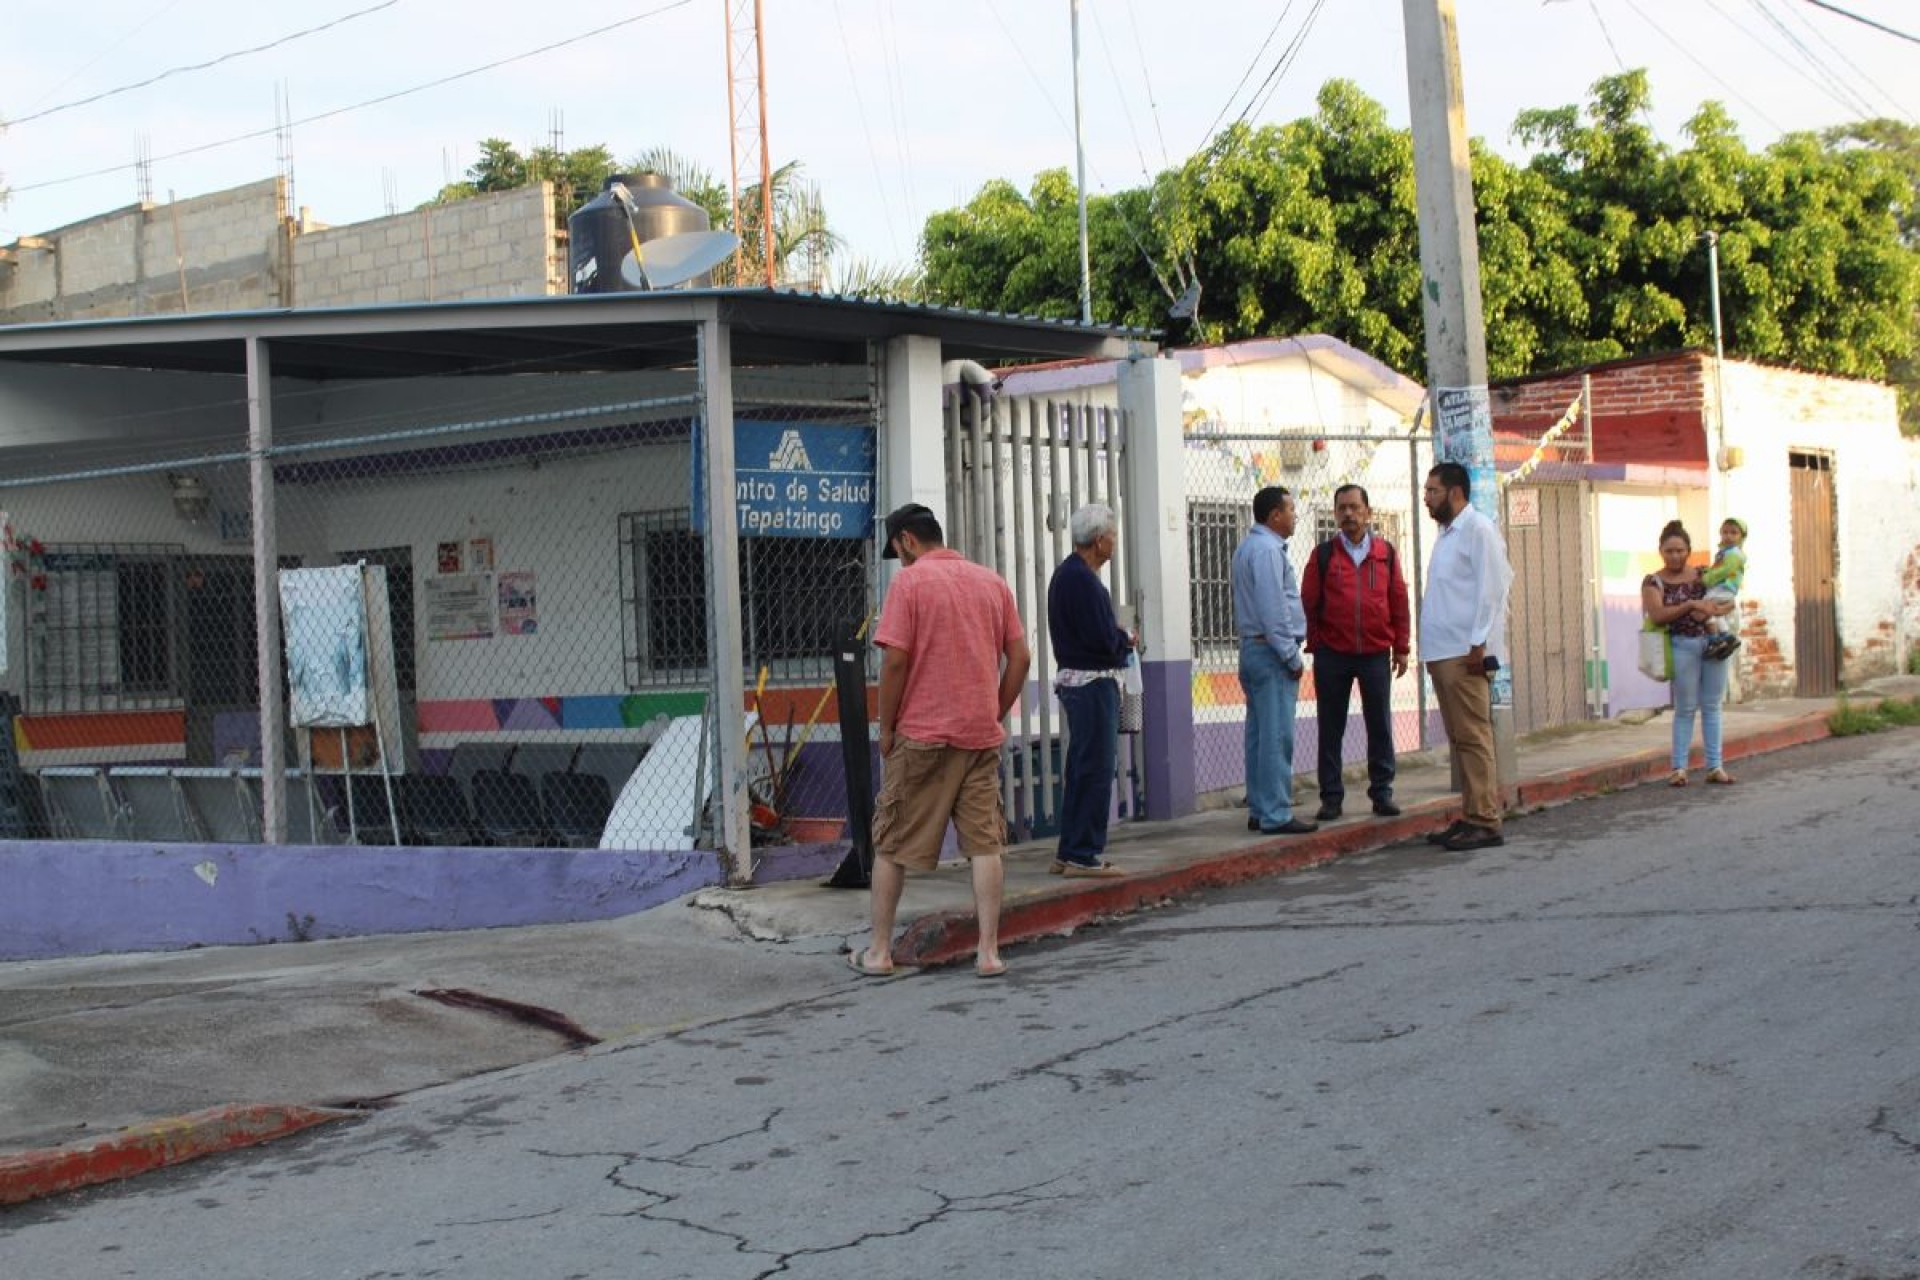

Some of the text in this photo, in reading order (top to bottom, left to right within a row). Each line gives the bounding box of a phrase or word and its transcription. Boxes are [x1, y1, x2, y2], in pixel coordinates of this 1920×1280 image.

[736, 477, 870, 503] ntro de Salud
[738, 504, 843, 535] Tepetzingo
